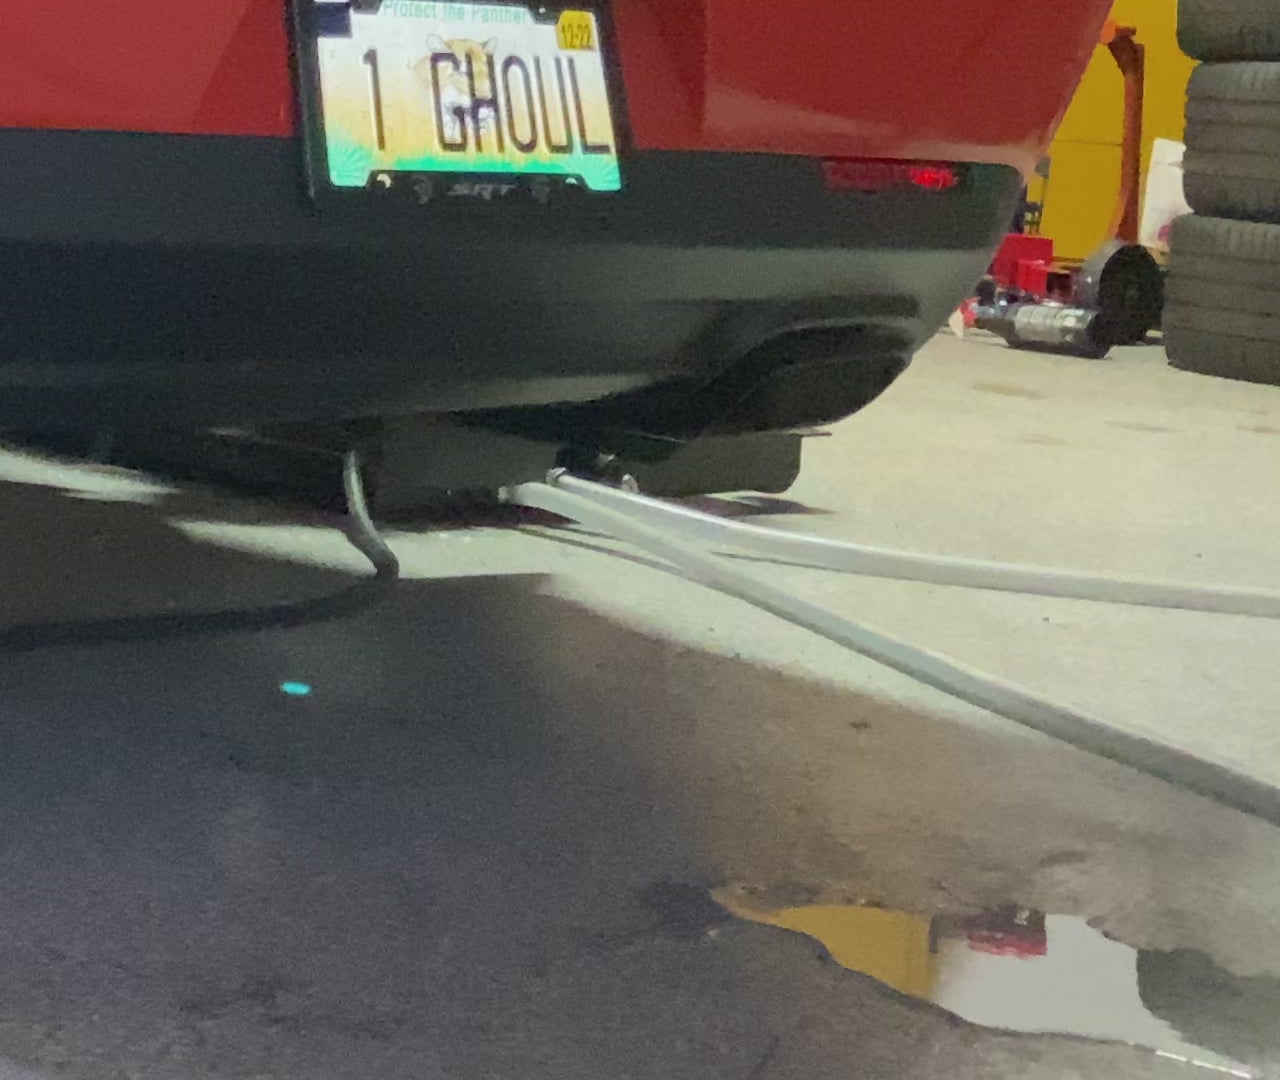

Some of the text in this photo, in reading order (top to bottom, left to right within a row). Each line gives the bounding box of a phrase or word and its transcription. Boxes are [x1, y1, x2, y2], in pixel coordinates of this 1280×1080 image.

[383, 1, 437, 19] Protect
[443, 5, 465, 21] the
[362, 48, 612, 156] 1 GHOUL
